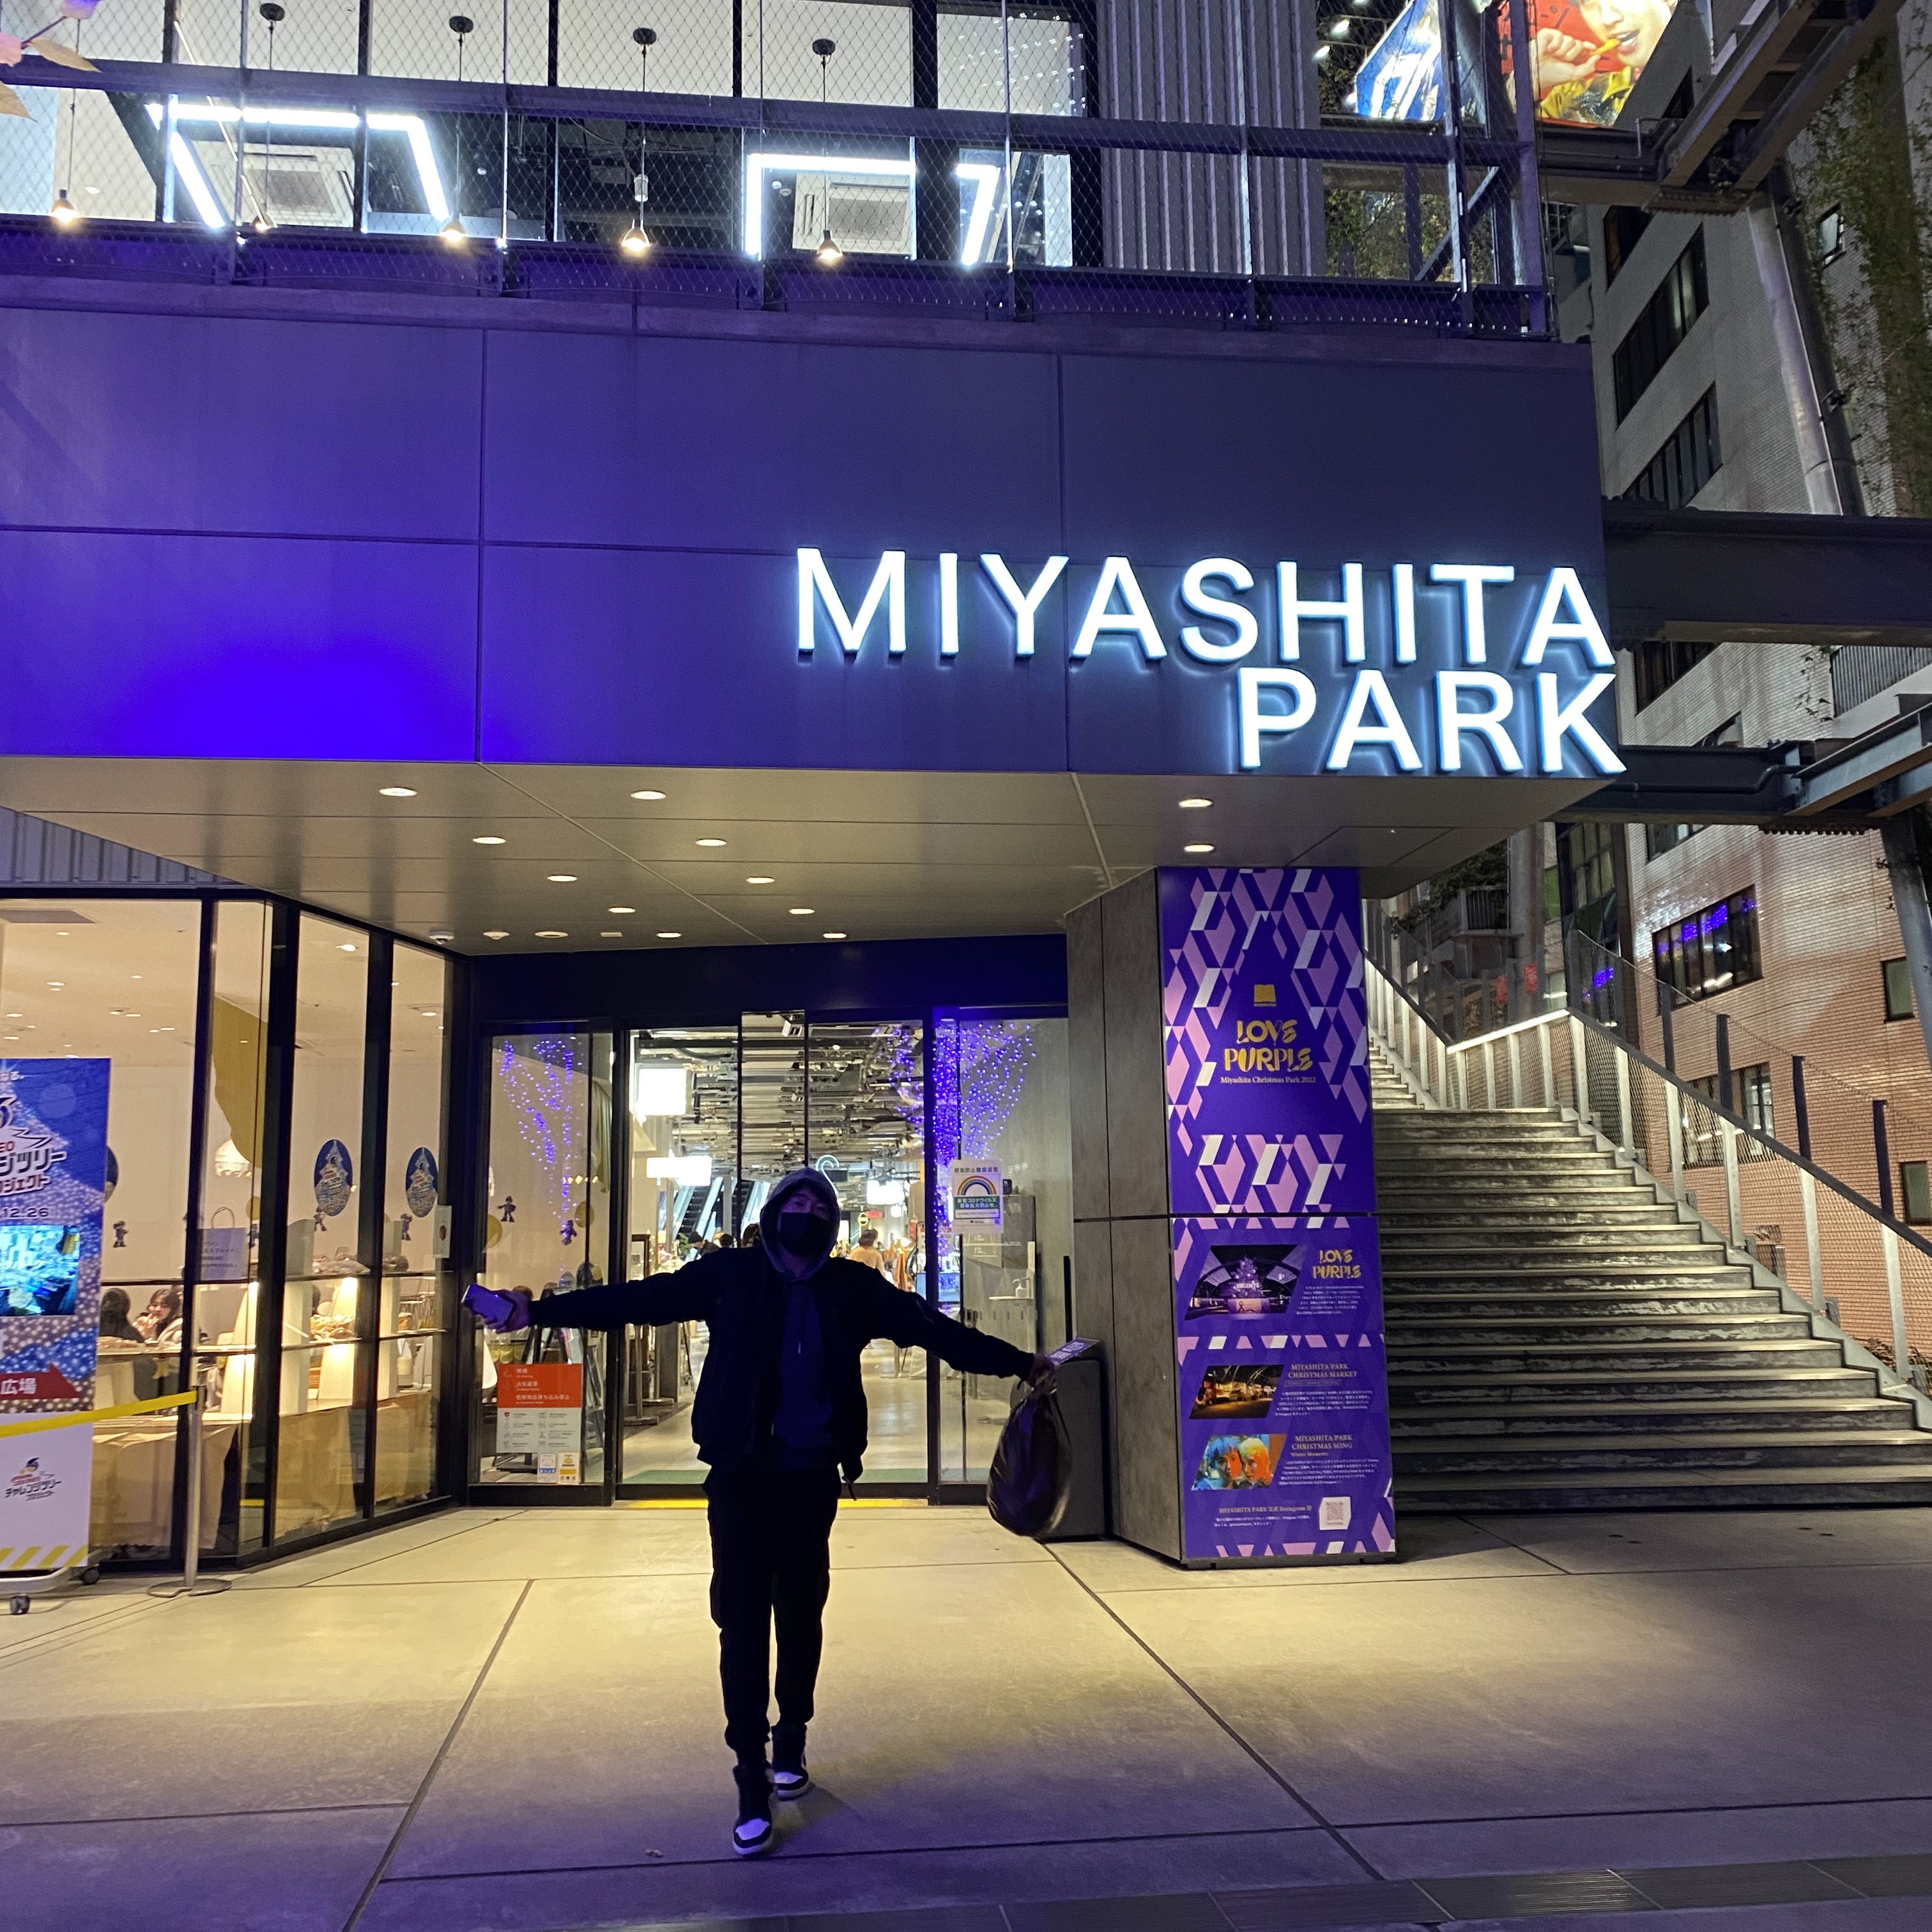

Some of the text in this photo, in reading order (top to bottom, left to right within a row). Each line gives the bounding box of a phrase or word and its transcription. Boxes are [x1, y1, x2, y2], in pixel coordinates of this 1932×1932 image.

[796, 547, 1615, 667] MIYASHITA
[1238, 667, 1627, 773] PARK
[1237, 1020, 1298, 1046] LOVE
[1225, 1048, 1313, 1072] PURPLE
[1221, 1076, 1252, 1085] Miyashita
[1319, 1249, 1353, 1264] LOVE
[1312, 1264, 1361, 1279] PURPLE
[1, 1377, 36, 1395] 広場
